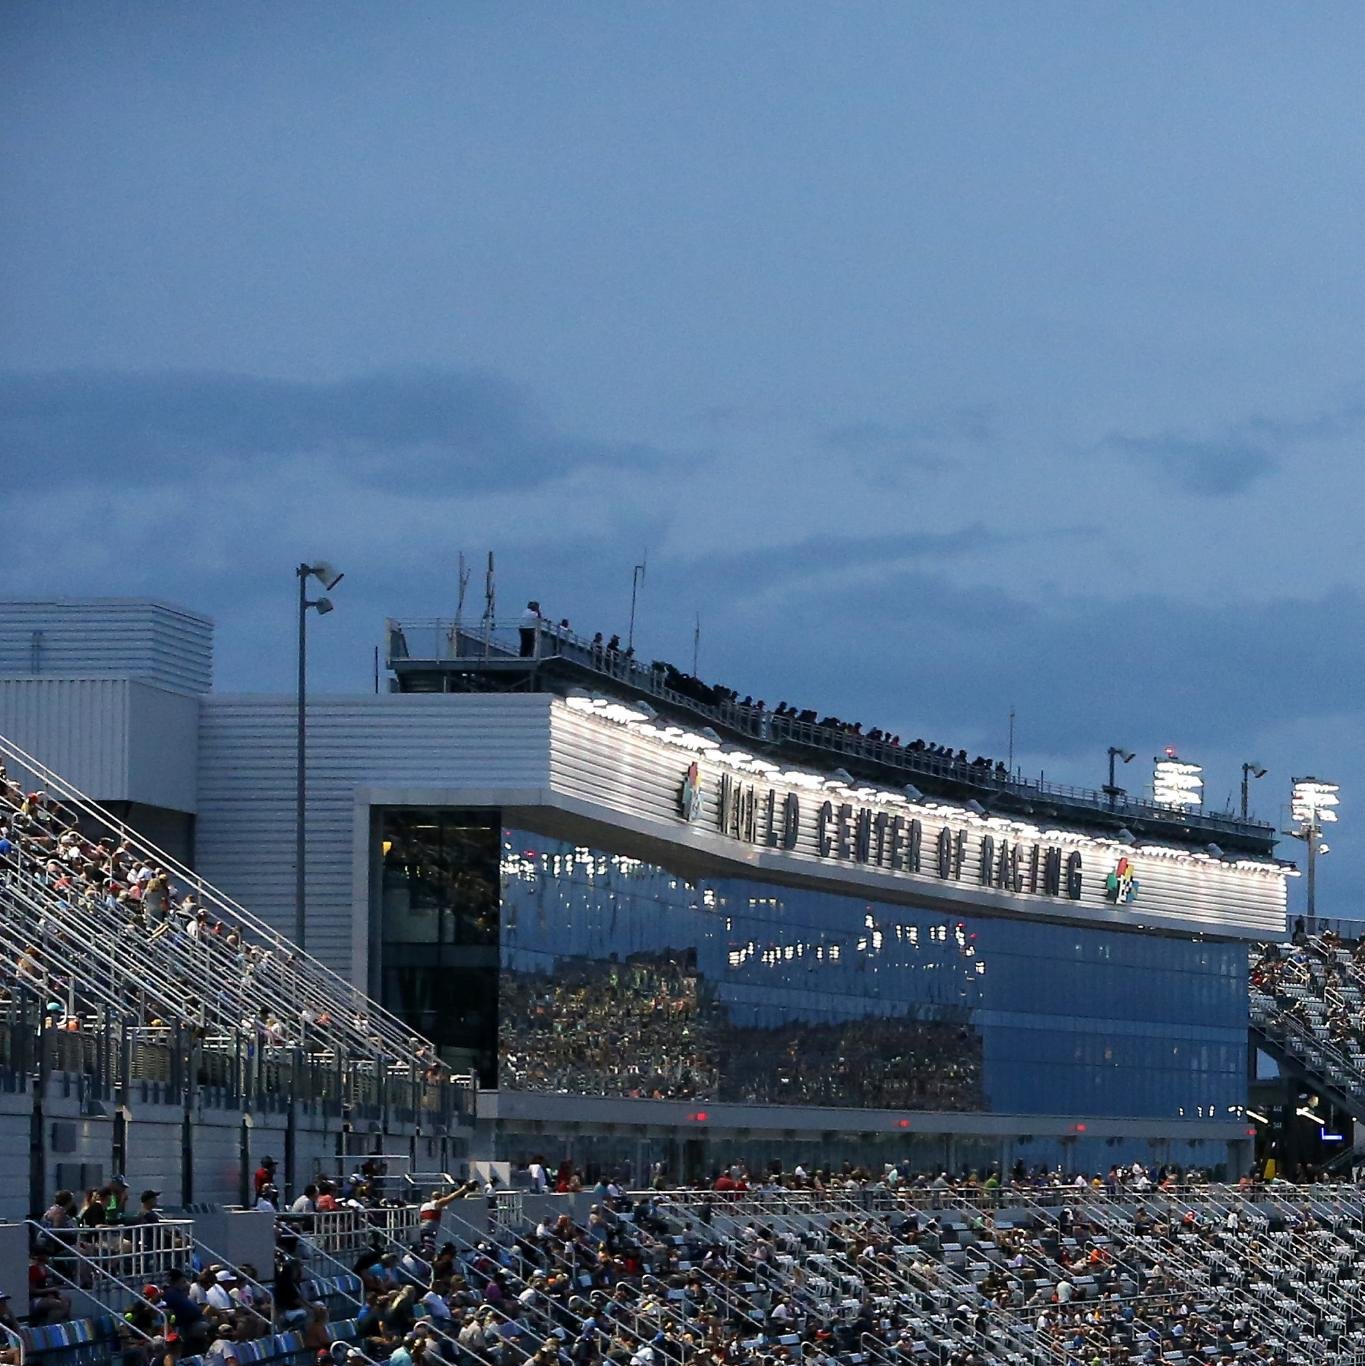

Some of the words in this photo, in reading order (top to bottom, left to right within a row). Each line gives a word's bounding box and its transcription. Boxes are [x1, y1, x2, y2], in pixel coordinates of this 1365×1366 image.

[719, 773, 800, 850] WORLD
[819, 800, 922, 873] CENTER
[939, 826, 968, 880] OF
[981, 834, 1083, 900] RACING
